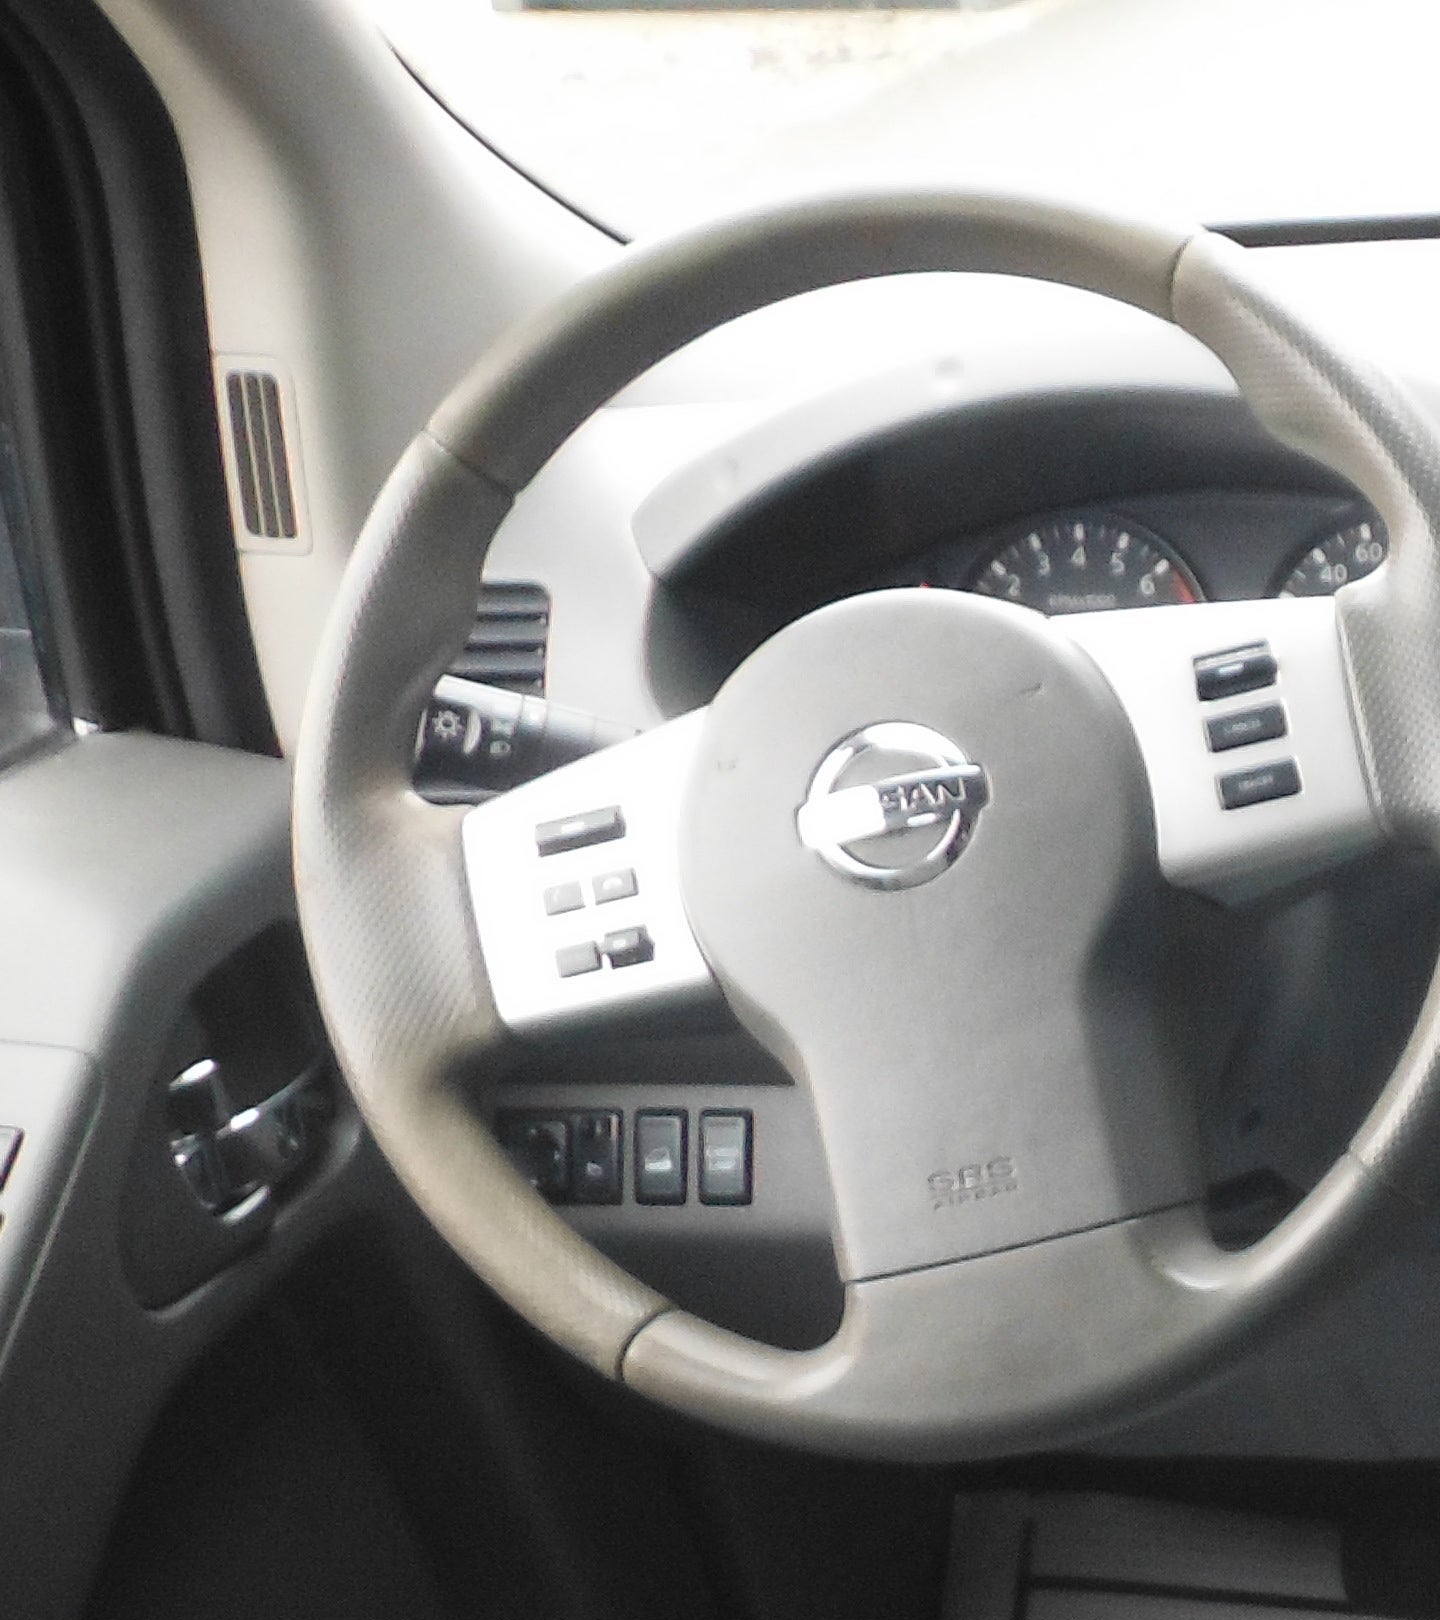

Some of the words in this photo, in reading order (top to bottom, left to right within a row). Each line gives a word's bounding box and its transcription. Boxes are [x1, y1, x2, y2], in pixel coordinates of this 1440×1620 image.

[1355, 541, 1382, 562] 60
[1008, 574, 1020, 597] 2
[1038, 553, 1050, 576] 3
[1071, 546, 1085, 568] 4
[1112, 552, 1125, 575] 5
[1140, 573, 1155, 596] 6
[1320, 563, 1348, 583] 40
